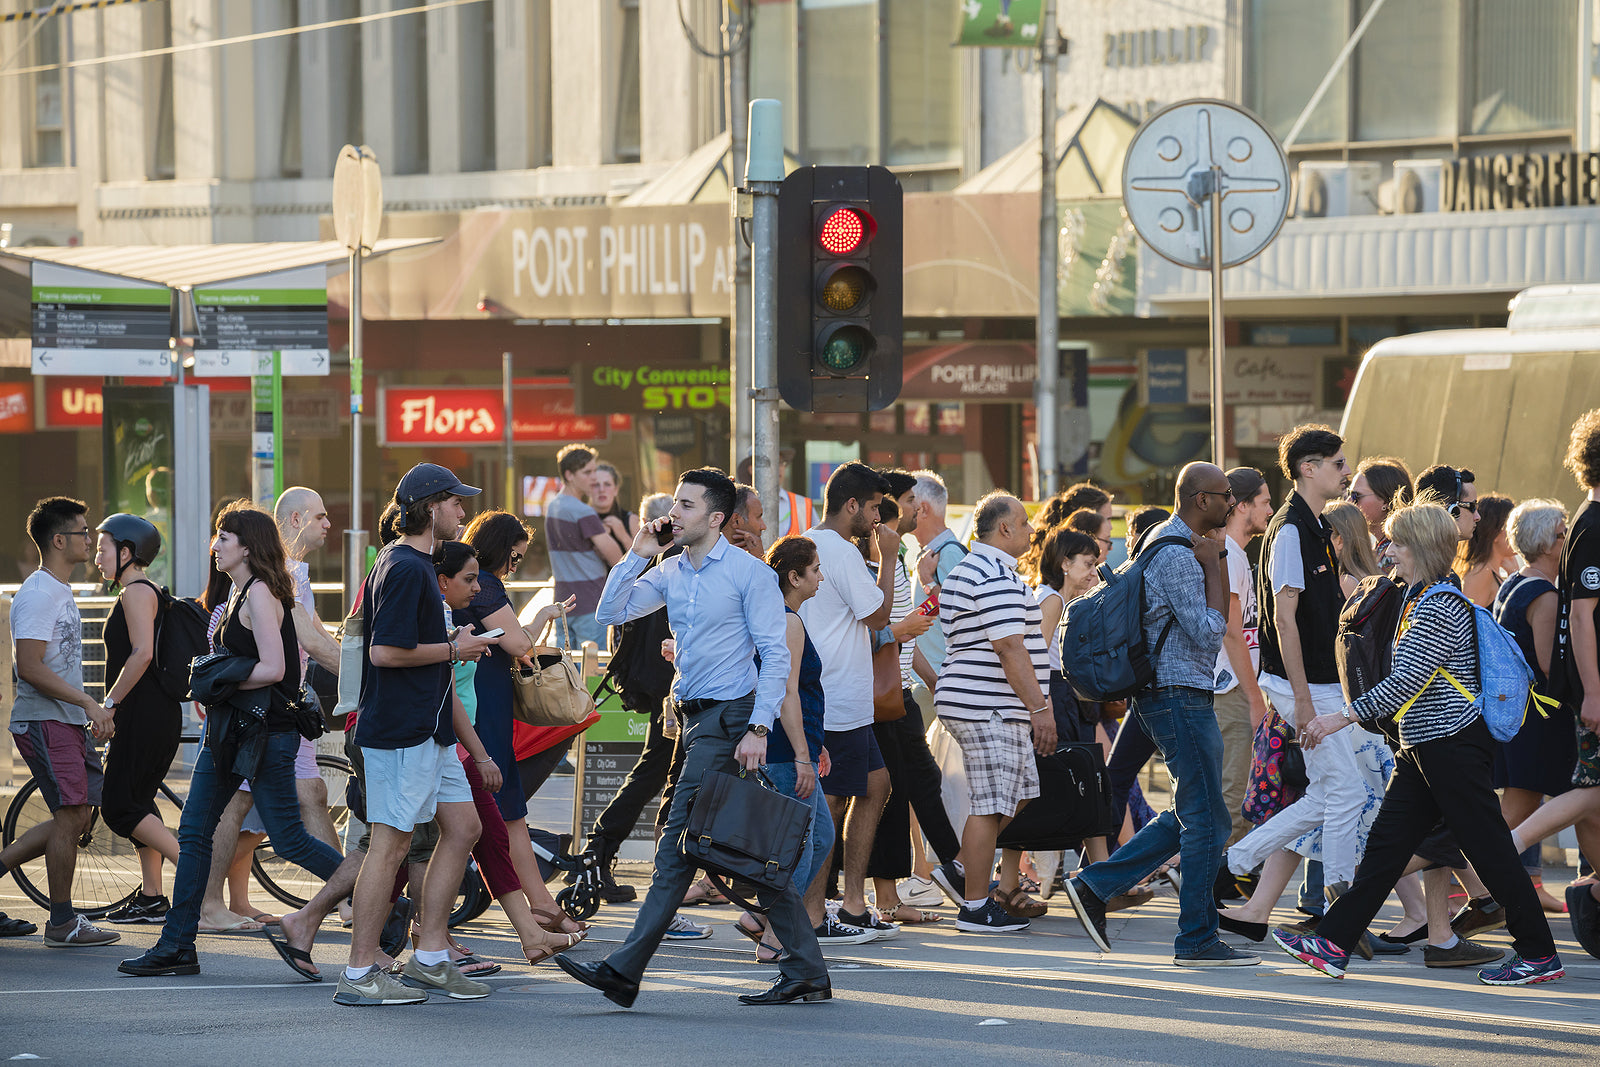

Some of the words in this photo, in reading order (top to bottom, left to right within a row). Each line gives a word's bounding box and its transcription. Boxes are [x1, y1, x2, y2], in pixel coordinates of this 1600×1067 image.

[1104, 25, 1209, 67] PHILLIP
[1438, 152, 1600, 212] DANGERFIE
[512, 226, 587, 298] PORT
[600, 222, 707, 295] PHILLIP
[160, 352, 168, 366] 5
[221, 351, 229, 366] 5
[931, 365, 975, 383] PORT
[592, 366, 633, 391] City
[400, 395, 496, 434] Flora
